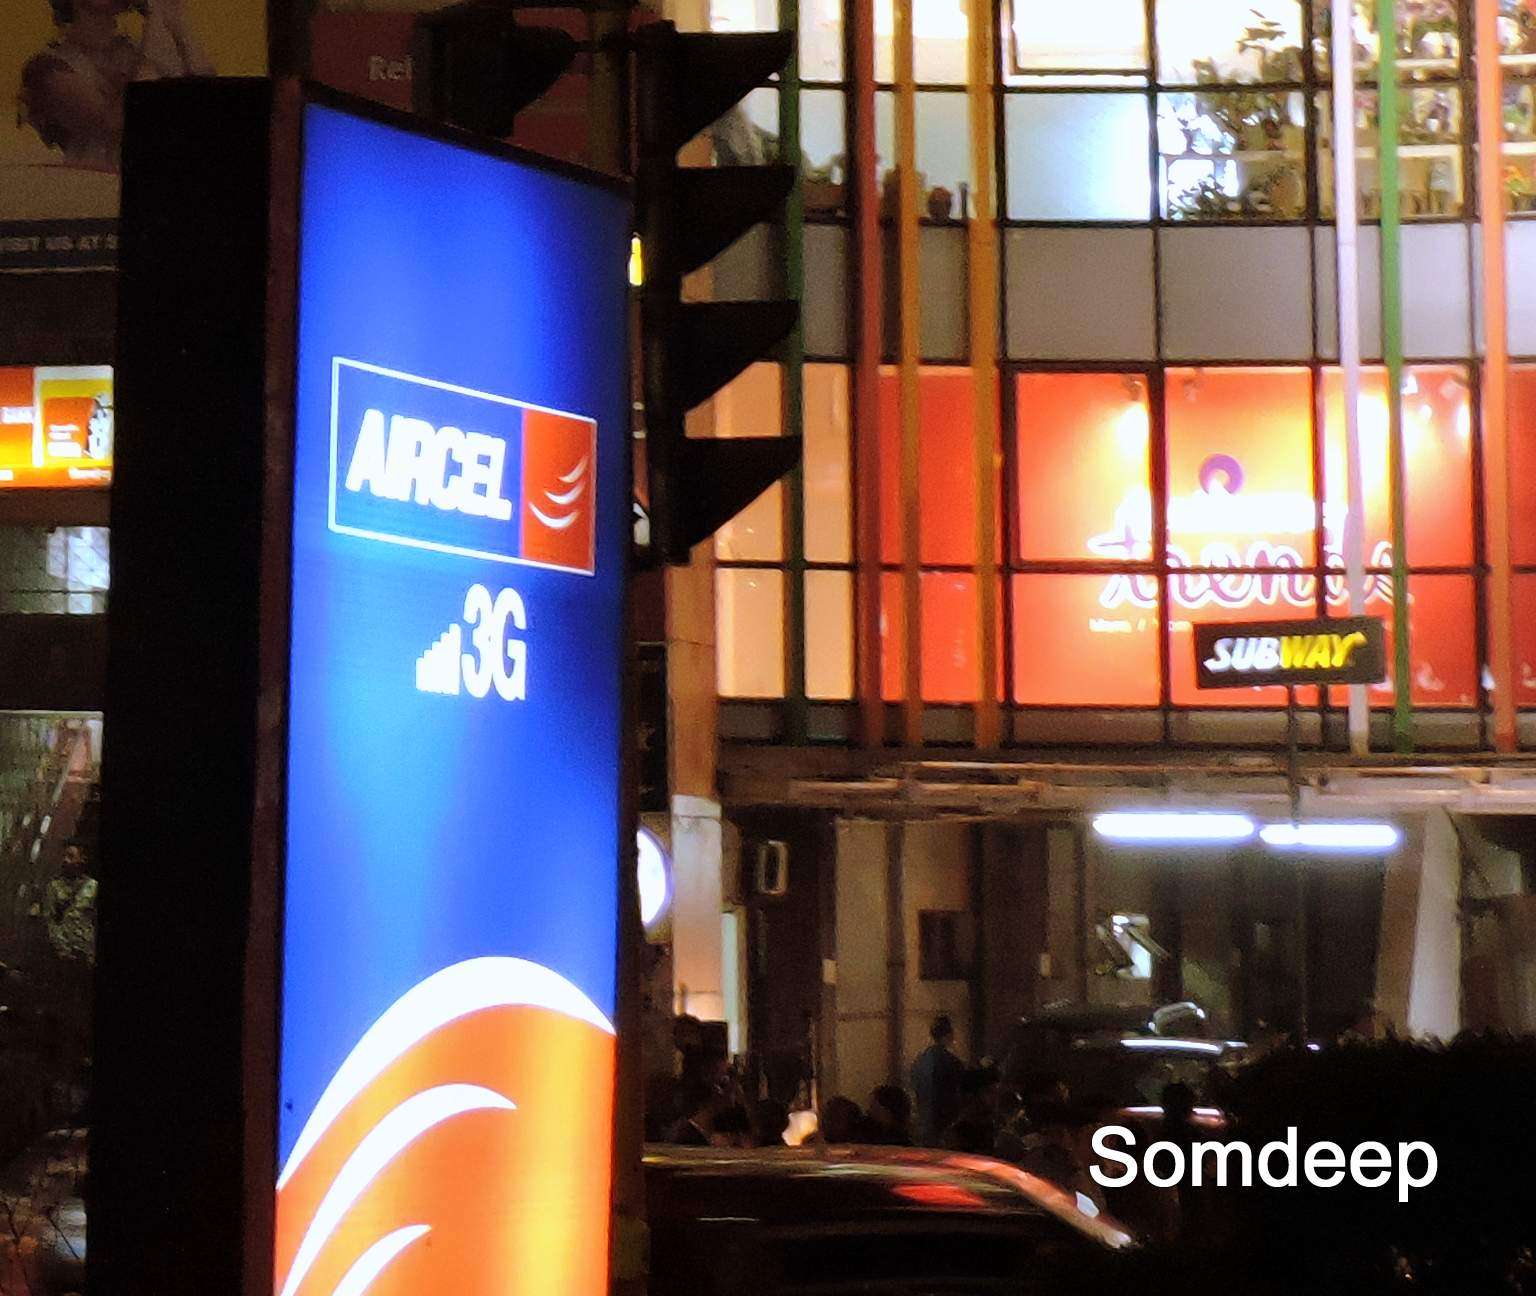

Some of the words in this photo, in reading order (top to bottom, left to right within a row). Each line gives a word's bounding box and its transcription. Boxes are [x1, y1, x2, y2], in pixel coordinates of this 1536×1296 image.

[344, 408, 513, 521] AIRCEL
[461, 582, 527, 701] 3G
[1204, 632, 1366, 672] SUBWAY
